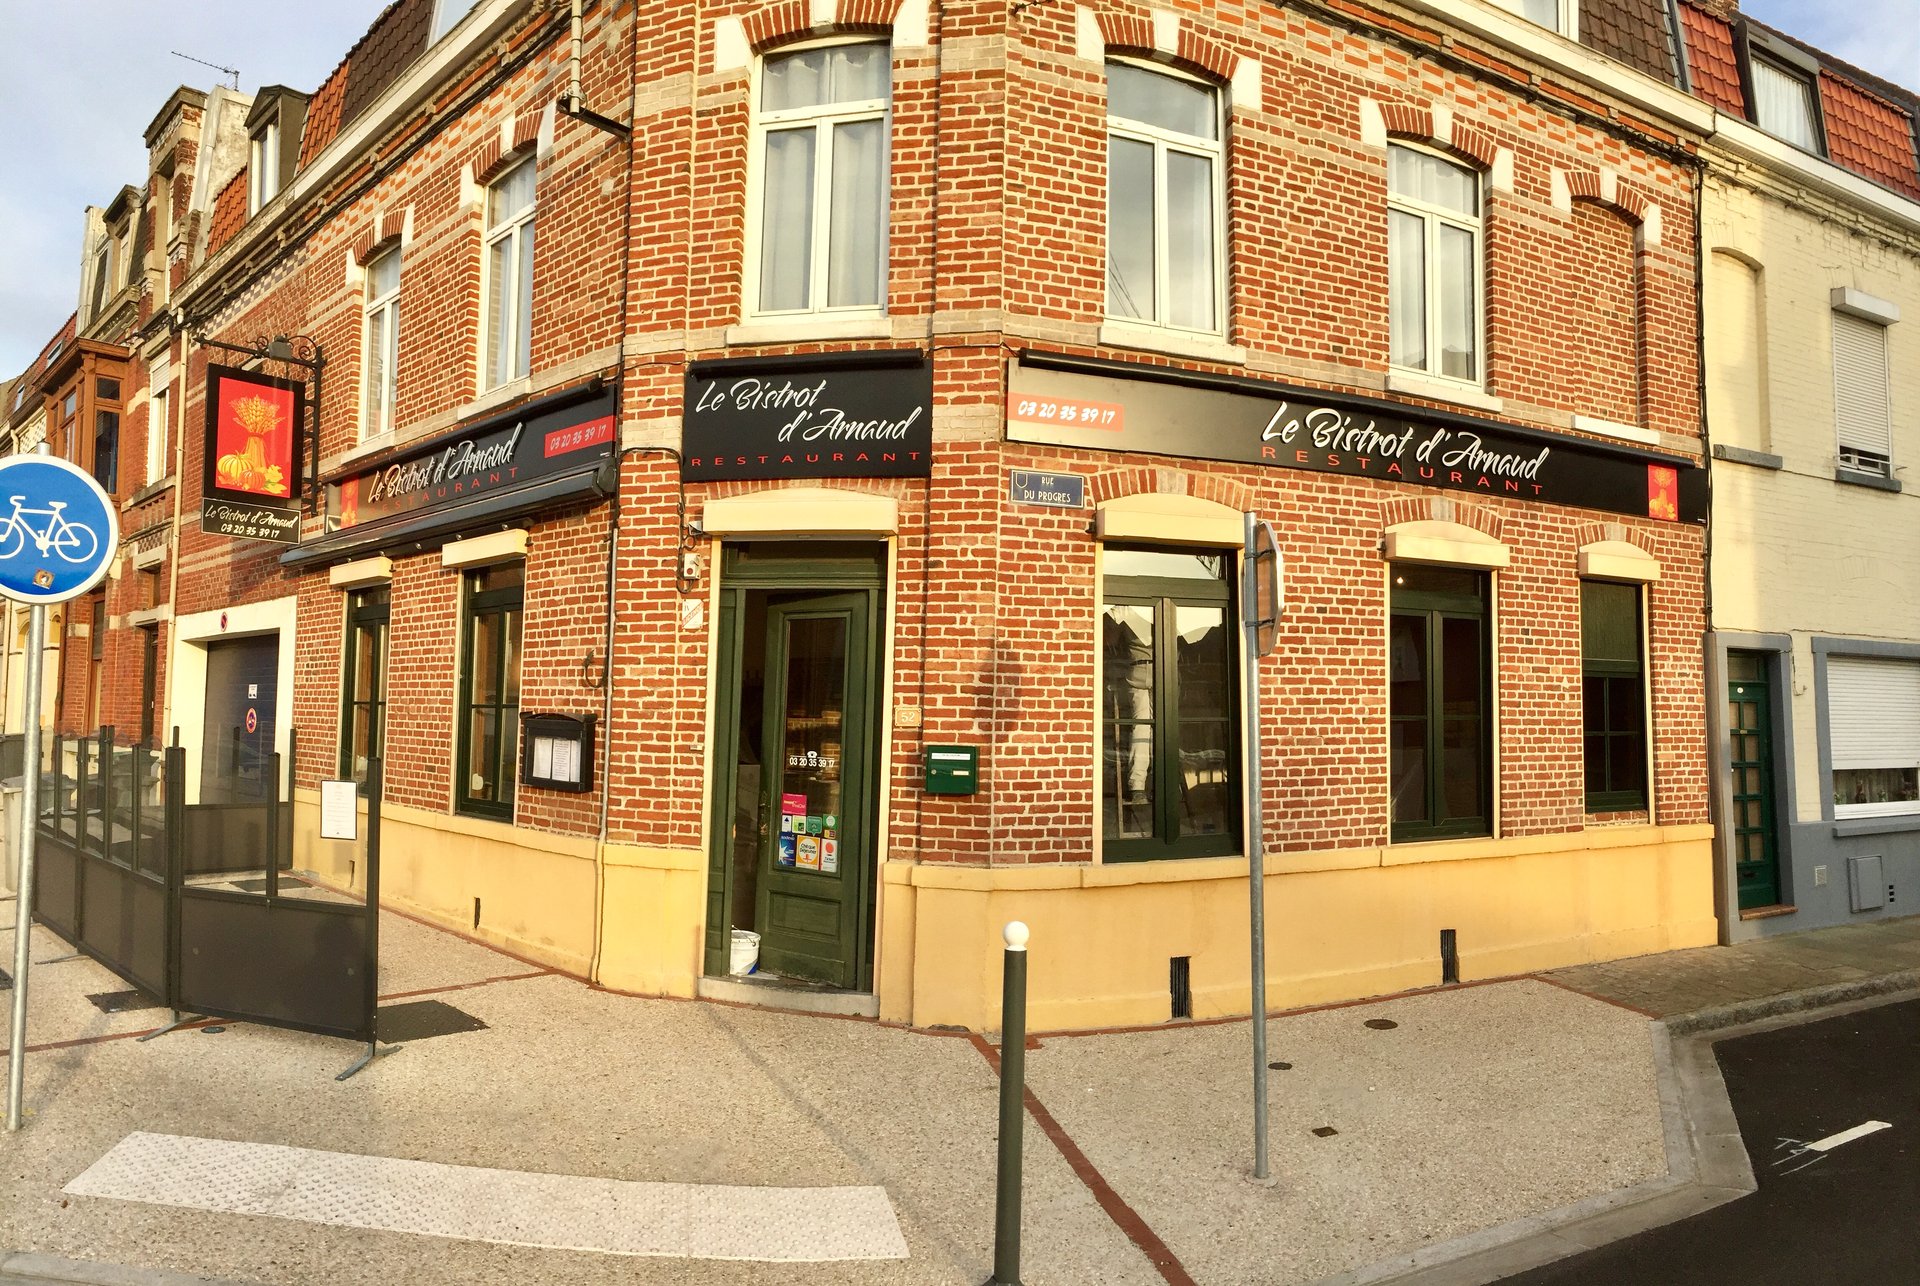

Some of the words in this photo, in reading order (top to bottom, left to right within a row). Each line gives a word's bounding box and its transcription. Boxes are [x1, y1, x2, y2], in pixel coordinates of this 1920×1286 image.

[694, 381, 726, 413] Le
[730, 378, 827, 410] Bistrot
[778, 406, 923, 442] d'Arnaud
[1018, 400, 1037, 416] 03
[1038, 403, 1057, 418] 20
[1060, 405, 1077, 421] 35
[1081, 408, 1099, 422] 39
[1101, 410, 1116, 425] 17
[550, 437, 561, 451] 03
[561, 433, 571, 449] 20
[572, 430, 583, 446] 35
[584, 427, 596, 442] 39
[597, 424, 607, 439] 17
[1261, 401, 1300, 444] Le
[1305, 408, 1414, 478] Bistrot
[1415, 427, 1550, 481] d'Arnaud
[367, 470, 386, 504] Le
[384, 457, 436, 498] Bistrot
[433, 421, 523, 484] d'Arnaud
[691, 452, 921, 466] RESTAURANT
[1261, 446, 1543, 495] RESTAURANT
[366, 466, 519, 515] RESTAURANT
[1041, 476, 1055, 485] RUE
[1024, 489, 1035, 500] DU
[1038, 491, 1071, 503] PROGRES
[205, 505, 217, 518] Le
[217, 506, 251, 522] Bistrot
[250, 511, 299, 529] d'Arnaud
[221, 523, 233, 533] 03
[233, 525, 245, 534] 20
[246, 526, 257, 536] 35
[259, 528, 271, 538] 39
[271, 529, 280, 538] 17
[901, 711, 915, 722] 52
[790, 757, 798, 766] 03
[799, 758, 808, 766] 20
[808, 758, 817, 767] 35
[818, 759, 827, 768] 39
[828, 760, 835, 768] 17
